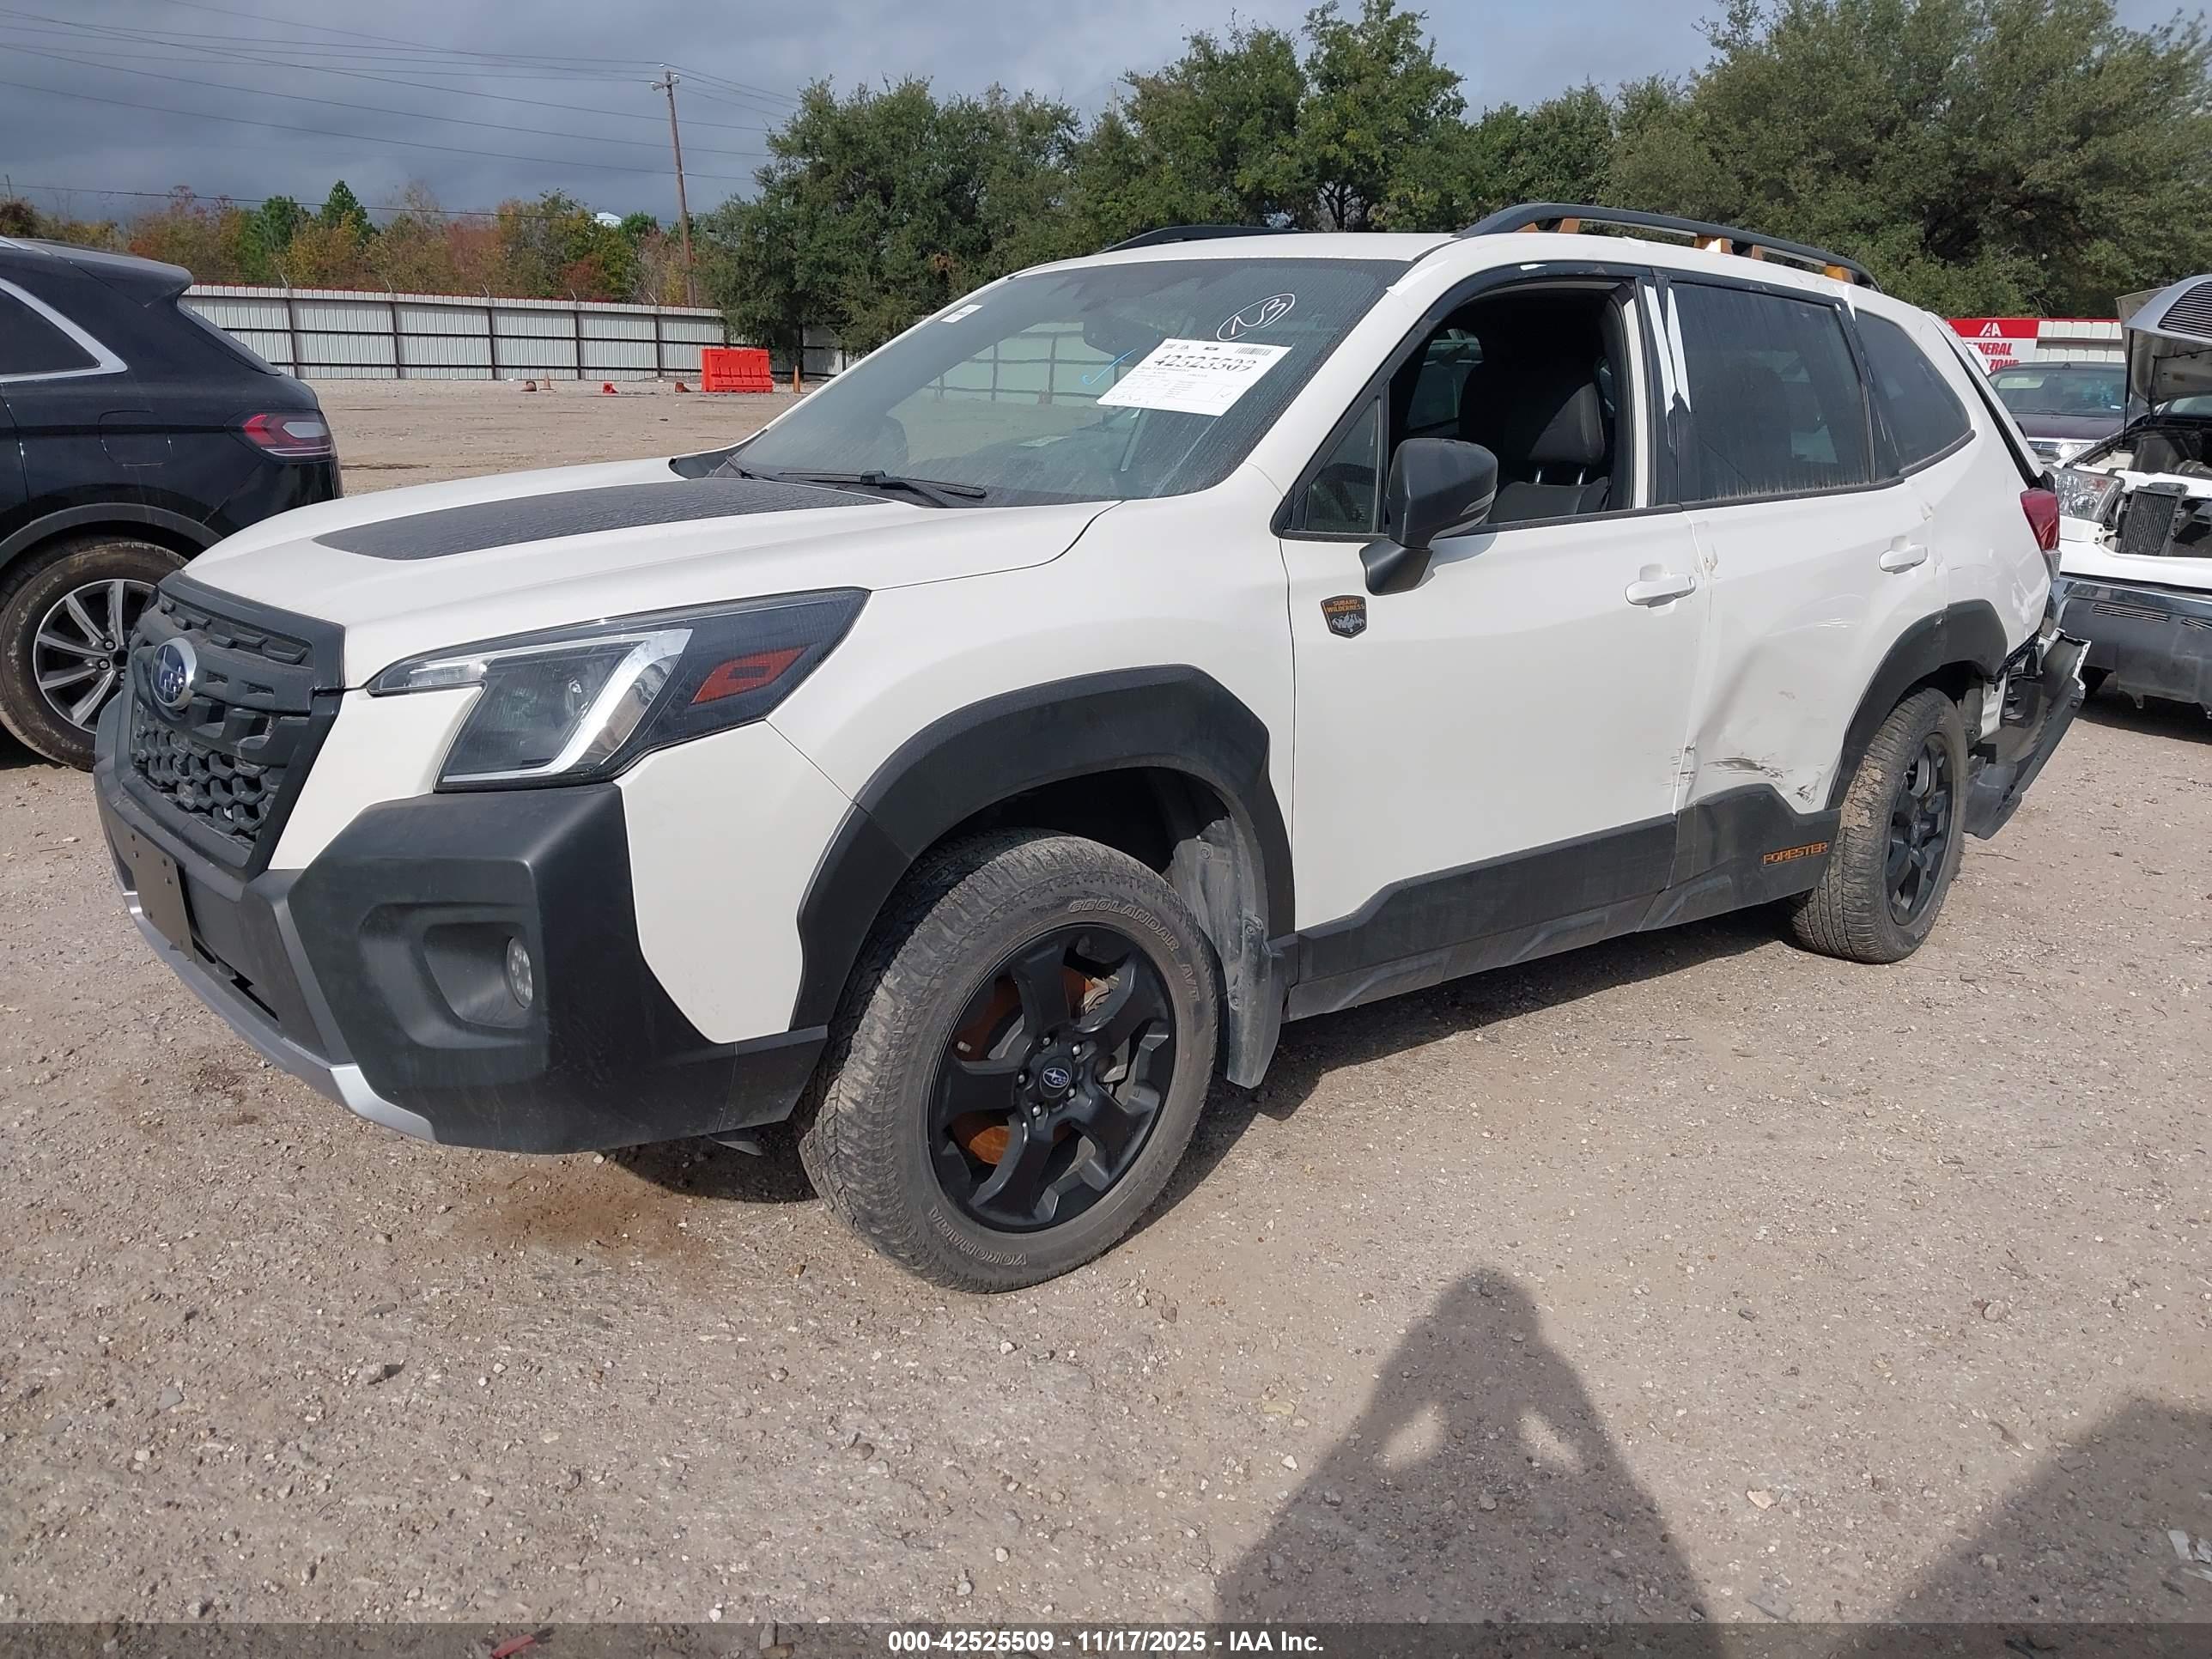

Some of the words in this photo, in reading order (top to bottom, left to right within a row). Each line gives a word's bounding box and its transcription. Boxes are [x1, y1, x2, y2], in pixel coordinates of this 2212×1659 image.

[1966, 342, 2012, 356] NERAL
[1154, 355, 1257, 372] 42525509
[1327, 603, 1365, 613] WILDERNESS
[1763, 842, 1828, 866] FORESTER
[1068, 899, 1179, 952] GEOLANDAR
[1181, 963, 1200, 1002] A/T
[929, 1207, 1027, 1266] YOKOHAMA
